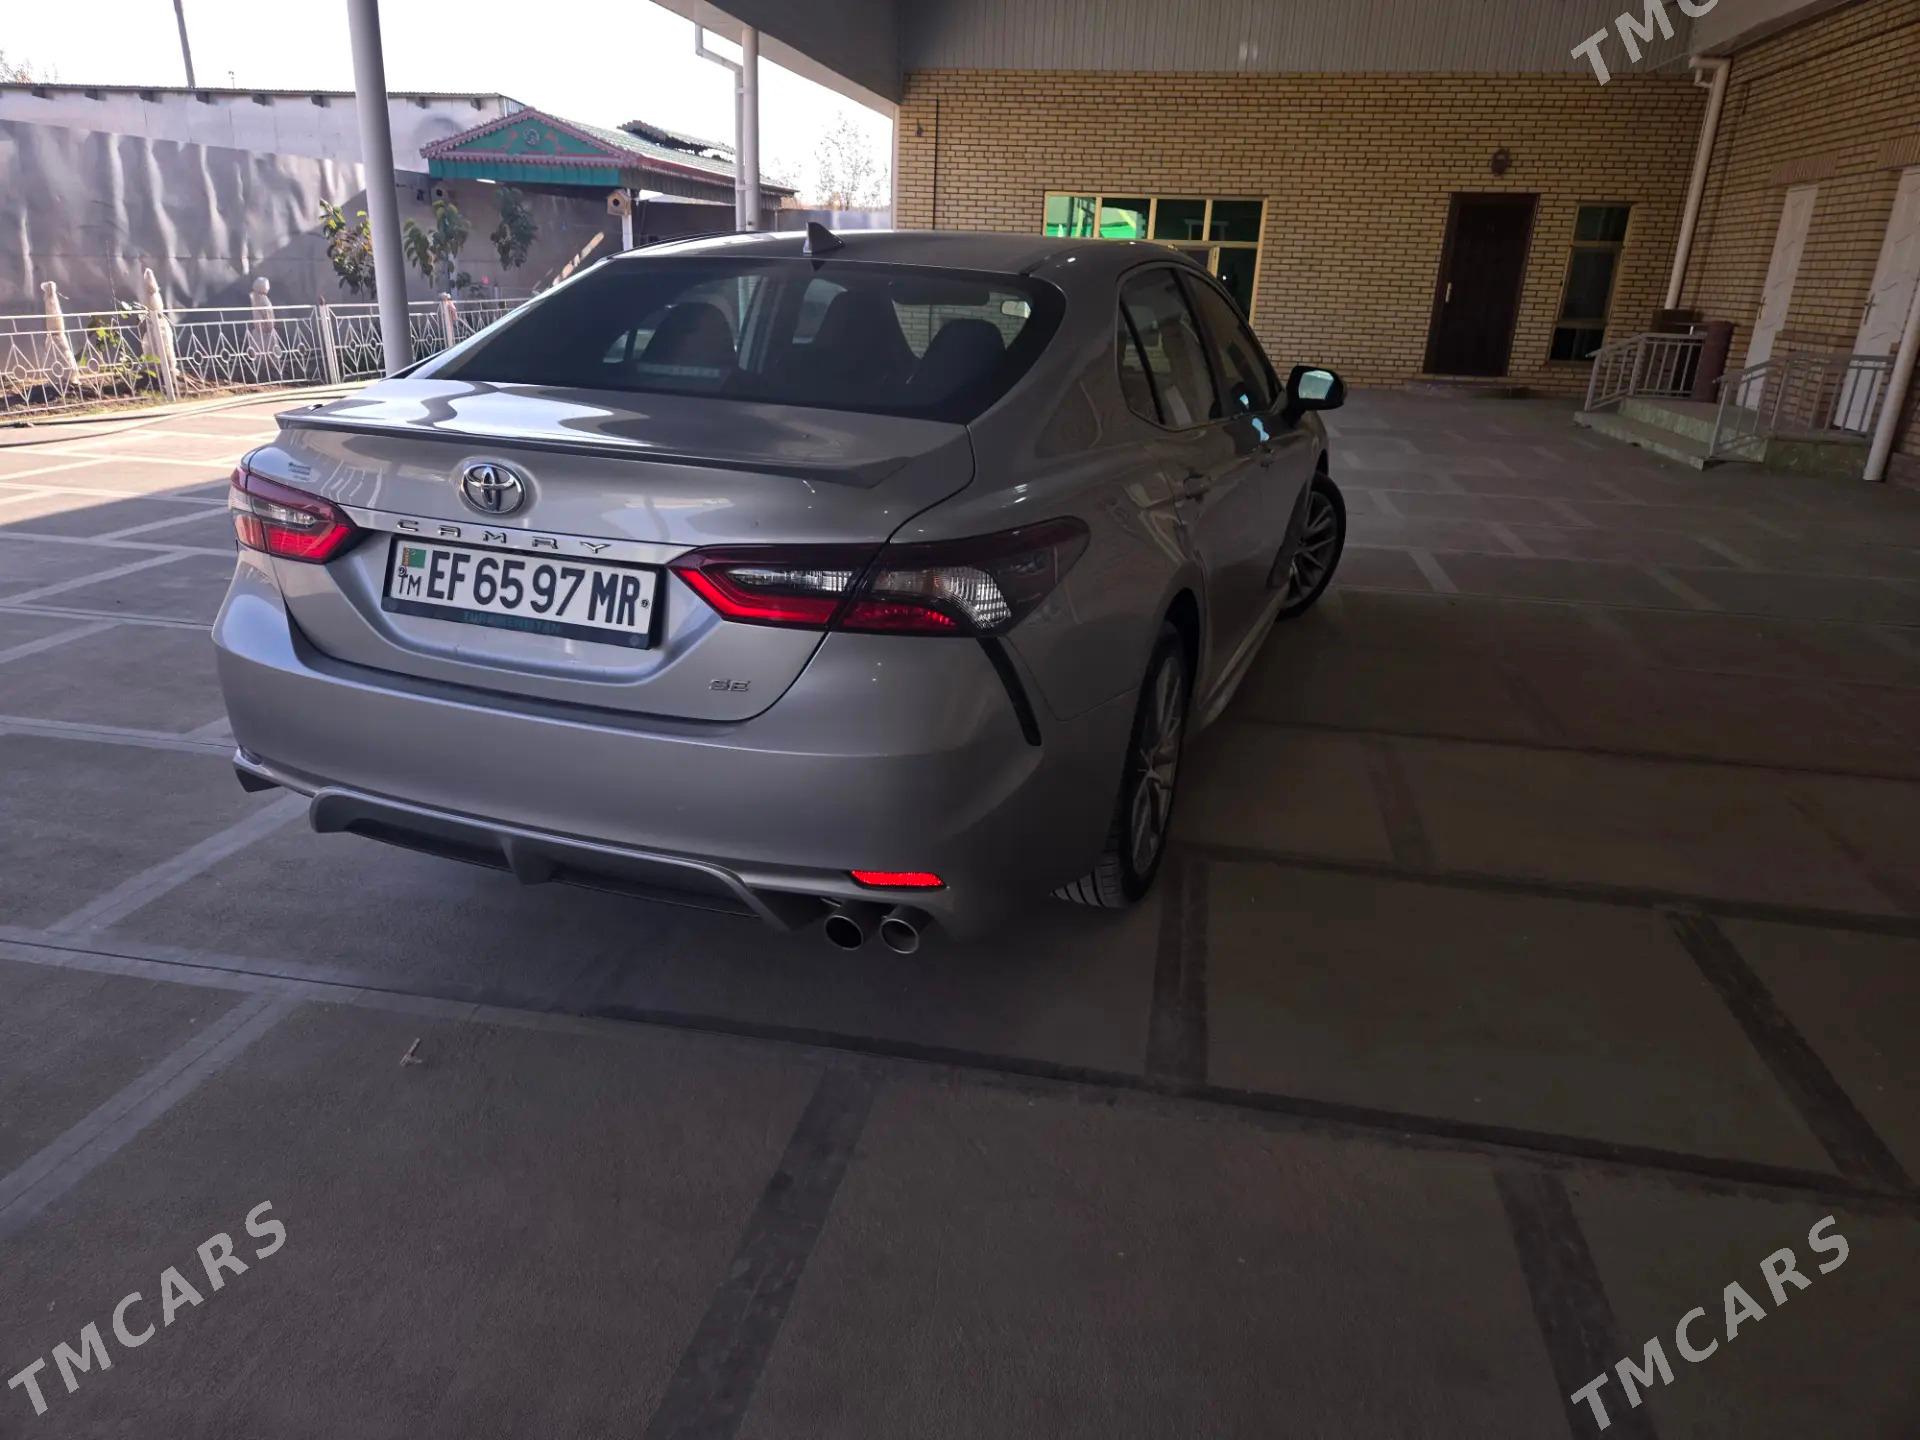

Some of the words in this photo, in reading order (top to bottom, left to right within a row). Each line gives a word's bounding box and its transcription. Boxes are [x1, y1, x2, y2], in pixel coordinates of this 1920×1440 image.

[397, 519, 611, 554] CAMRY
[398, 573, 422, 597] TM
[708, 680, 751, 692] SE
